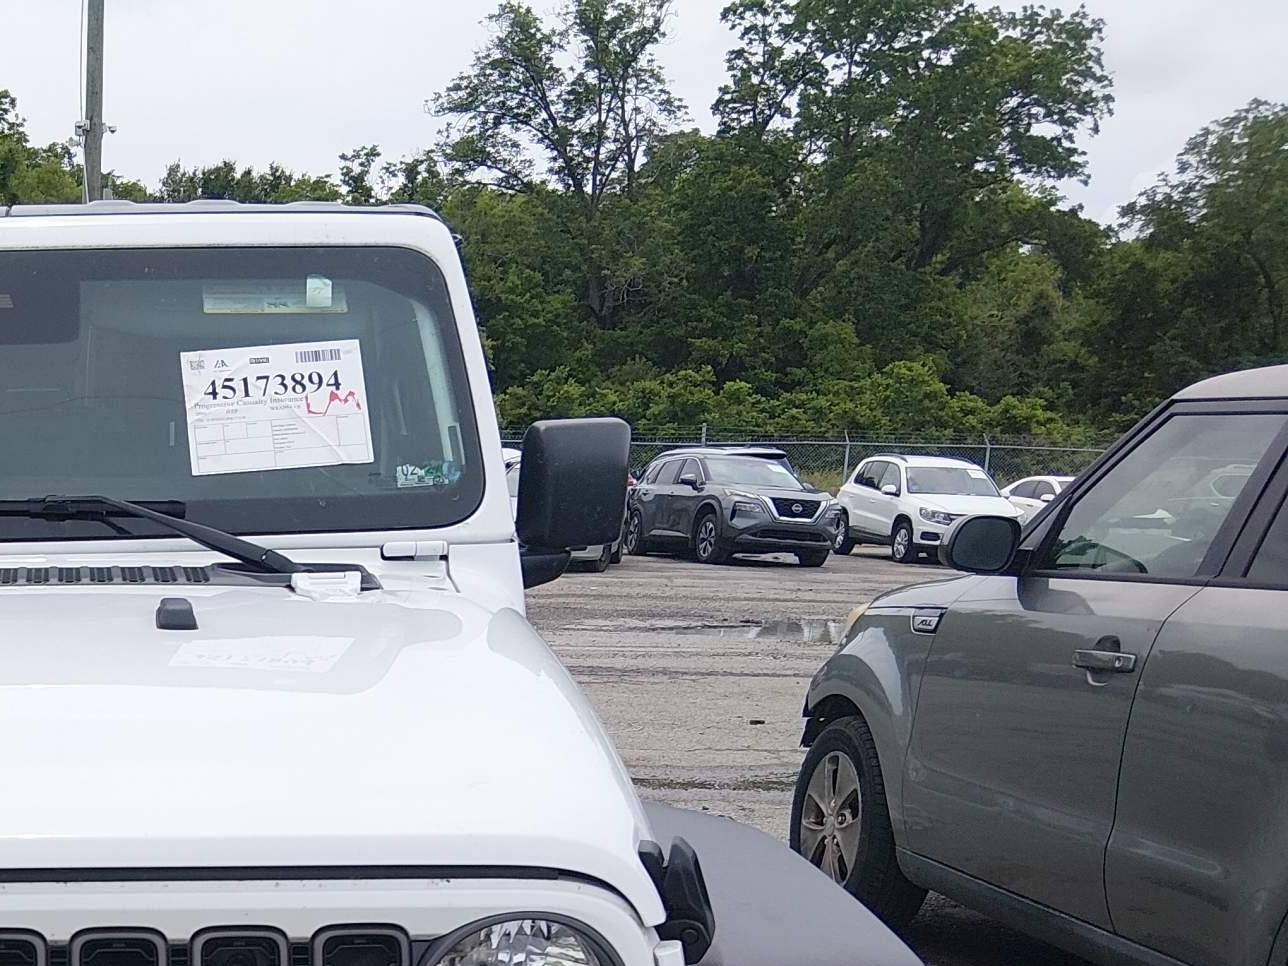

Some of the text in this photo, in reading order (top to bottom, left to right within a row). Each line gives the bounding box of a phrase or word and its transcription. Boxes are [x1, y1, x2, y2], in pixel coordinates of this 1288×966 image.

[204, 369, 342, 401] 45173894
[236, 396, 268, 408] Casualty
[270, 394, 304, 405] Insurance
